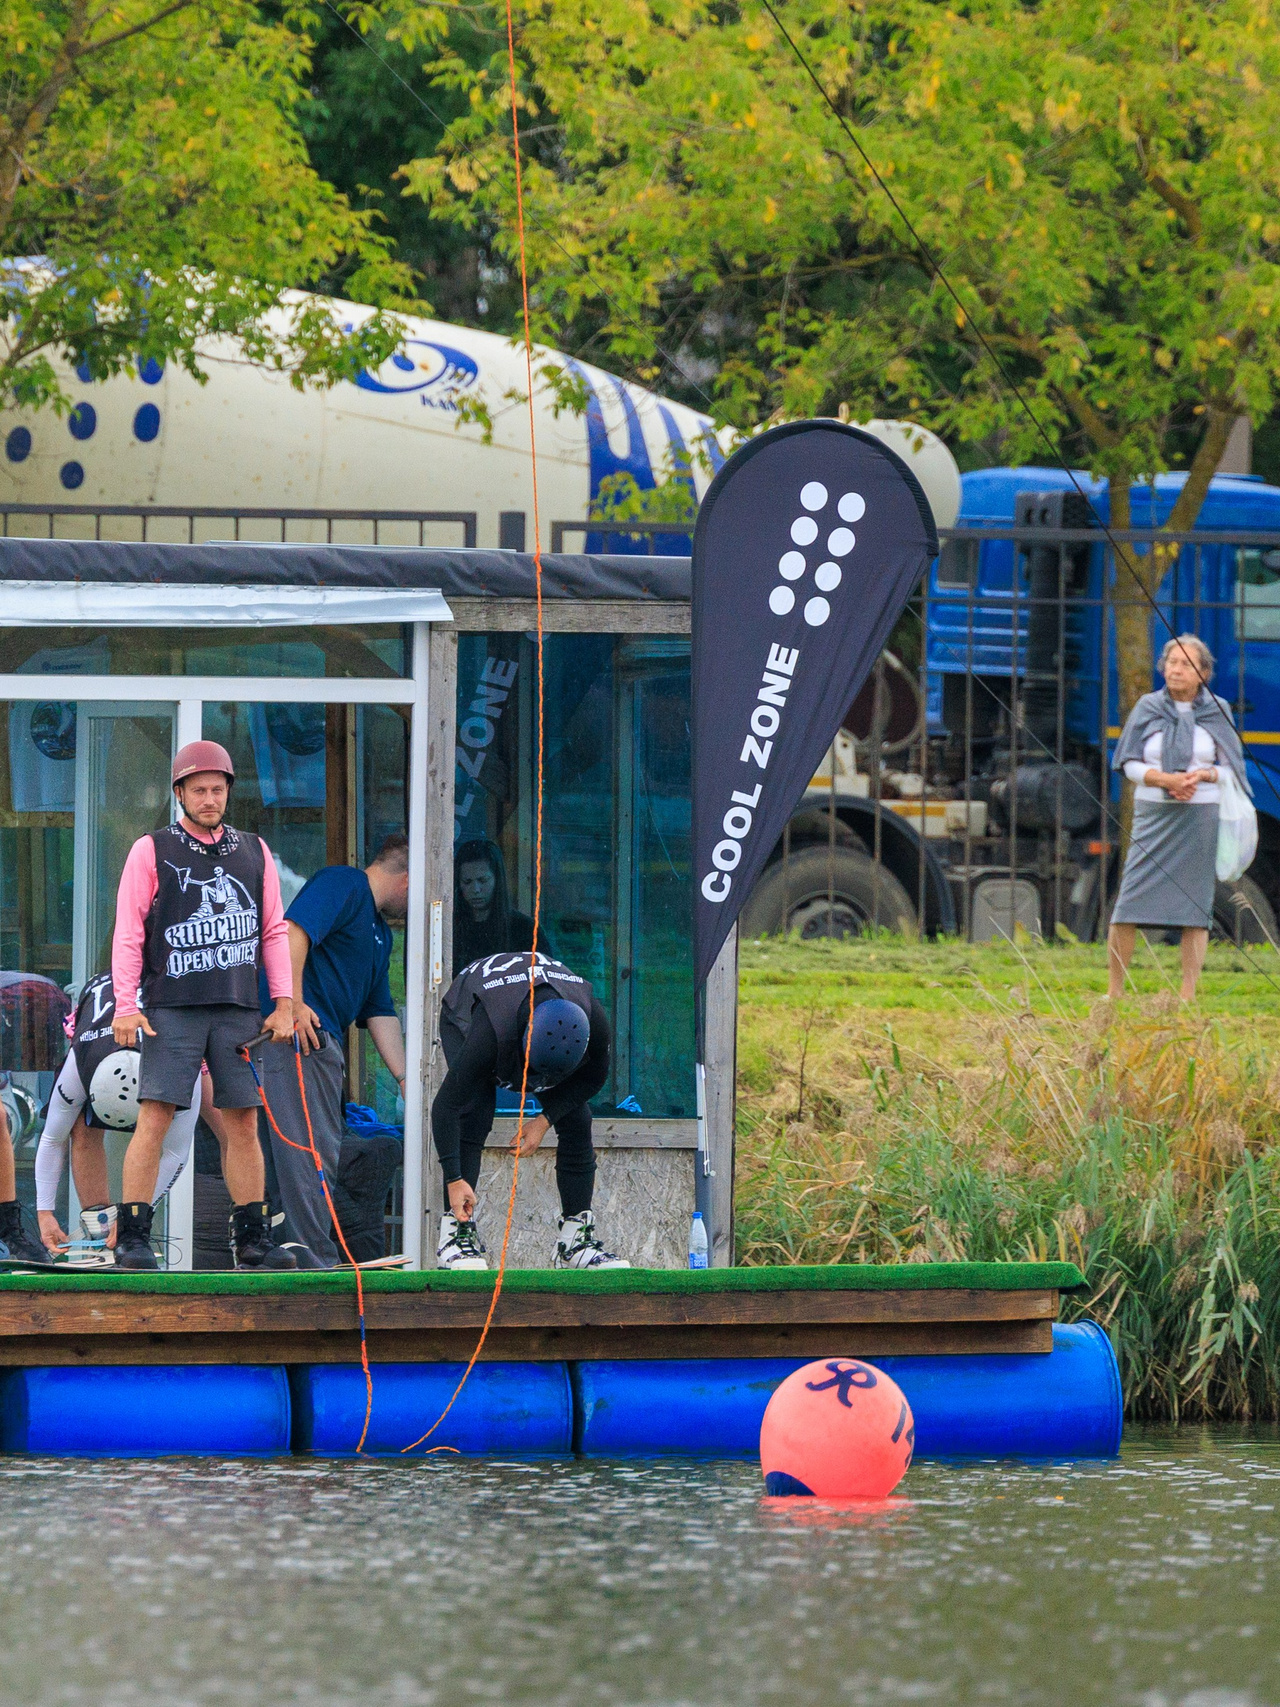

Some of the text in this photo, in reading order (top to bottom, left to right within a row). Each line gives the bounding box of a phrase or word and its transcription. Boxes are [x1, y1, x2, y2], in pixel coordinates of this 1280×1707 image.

[457, 656, 519, 780] ZONE
[700, 641, 800, 903] COOL ZONE
[167, 939, 259, 978] OPEN CONTES
[99, 1026, 114, 1038] AKE
